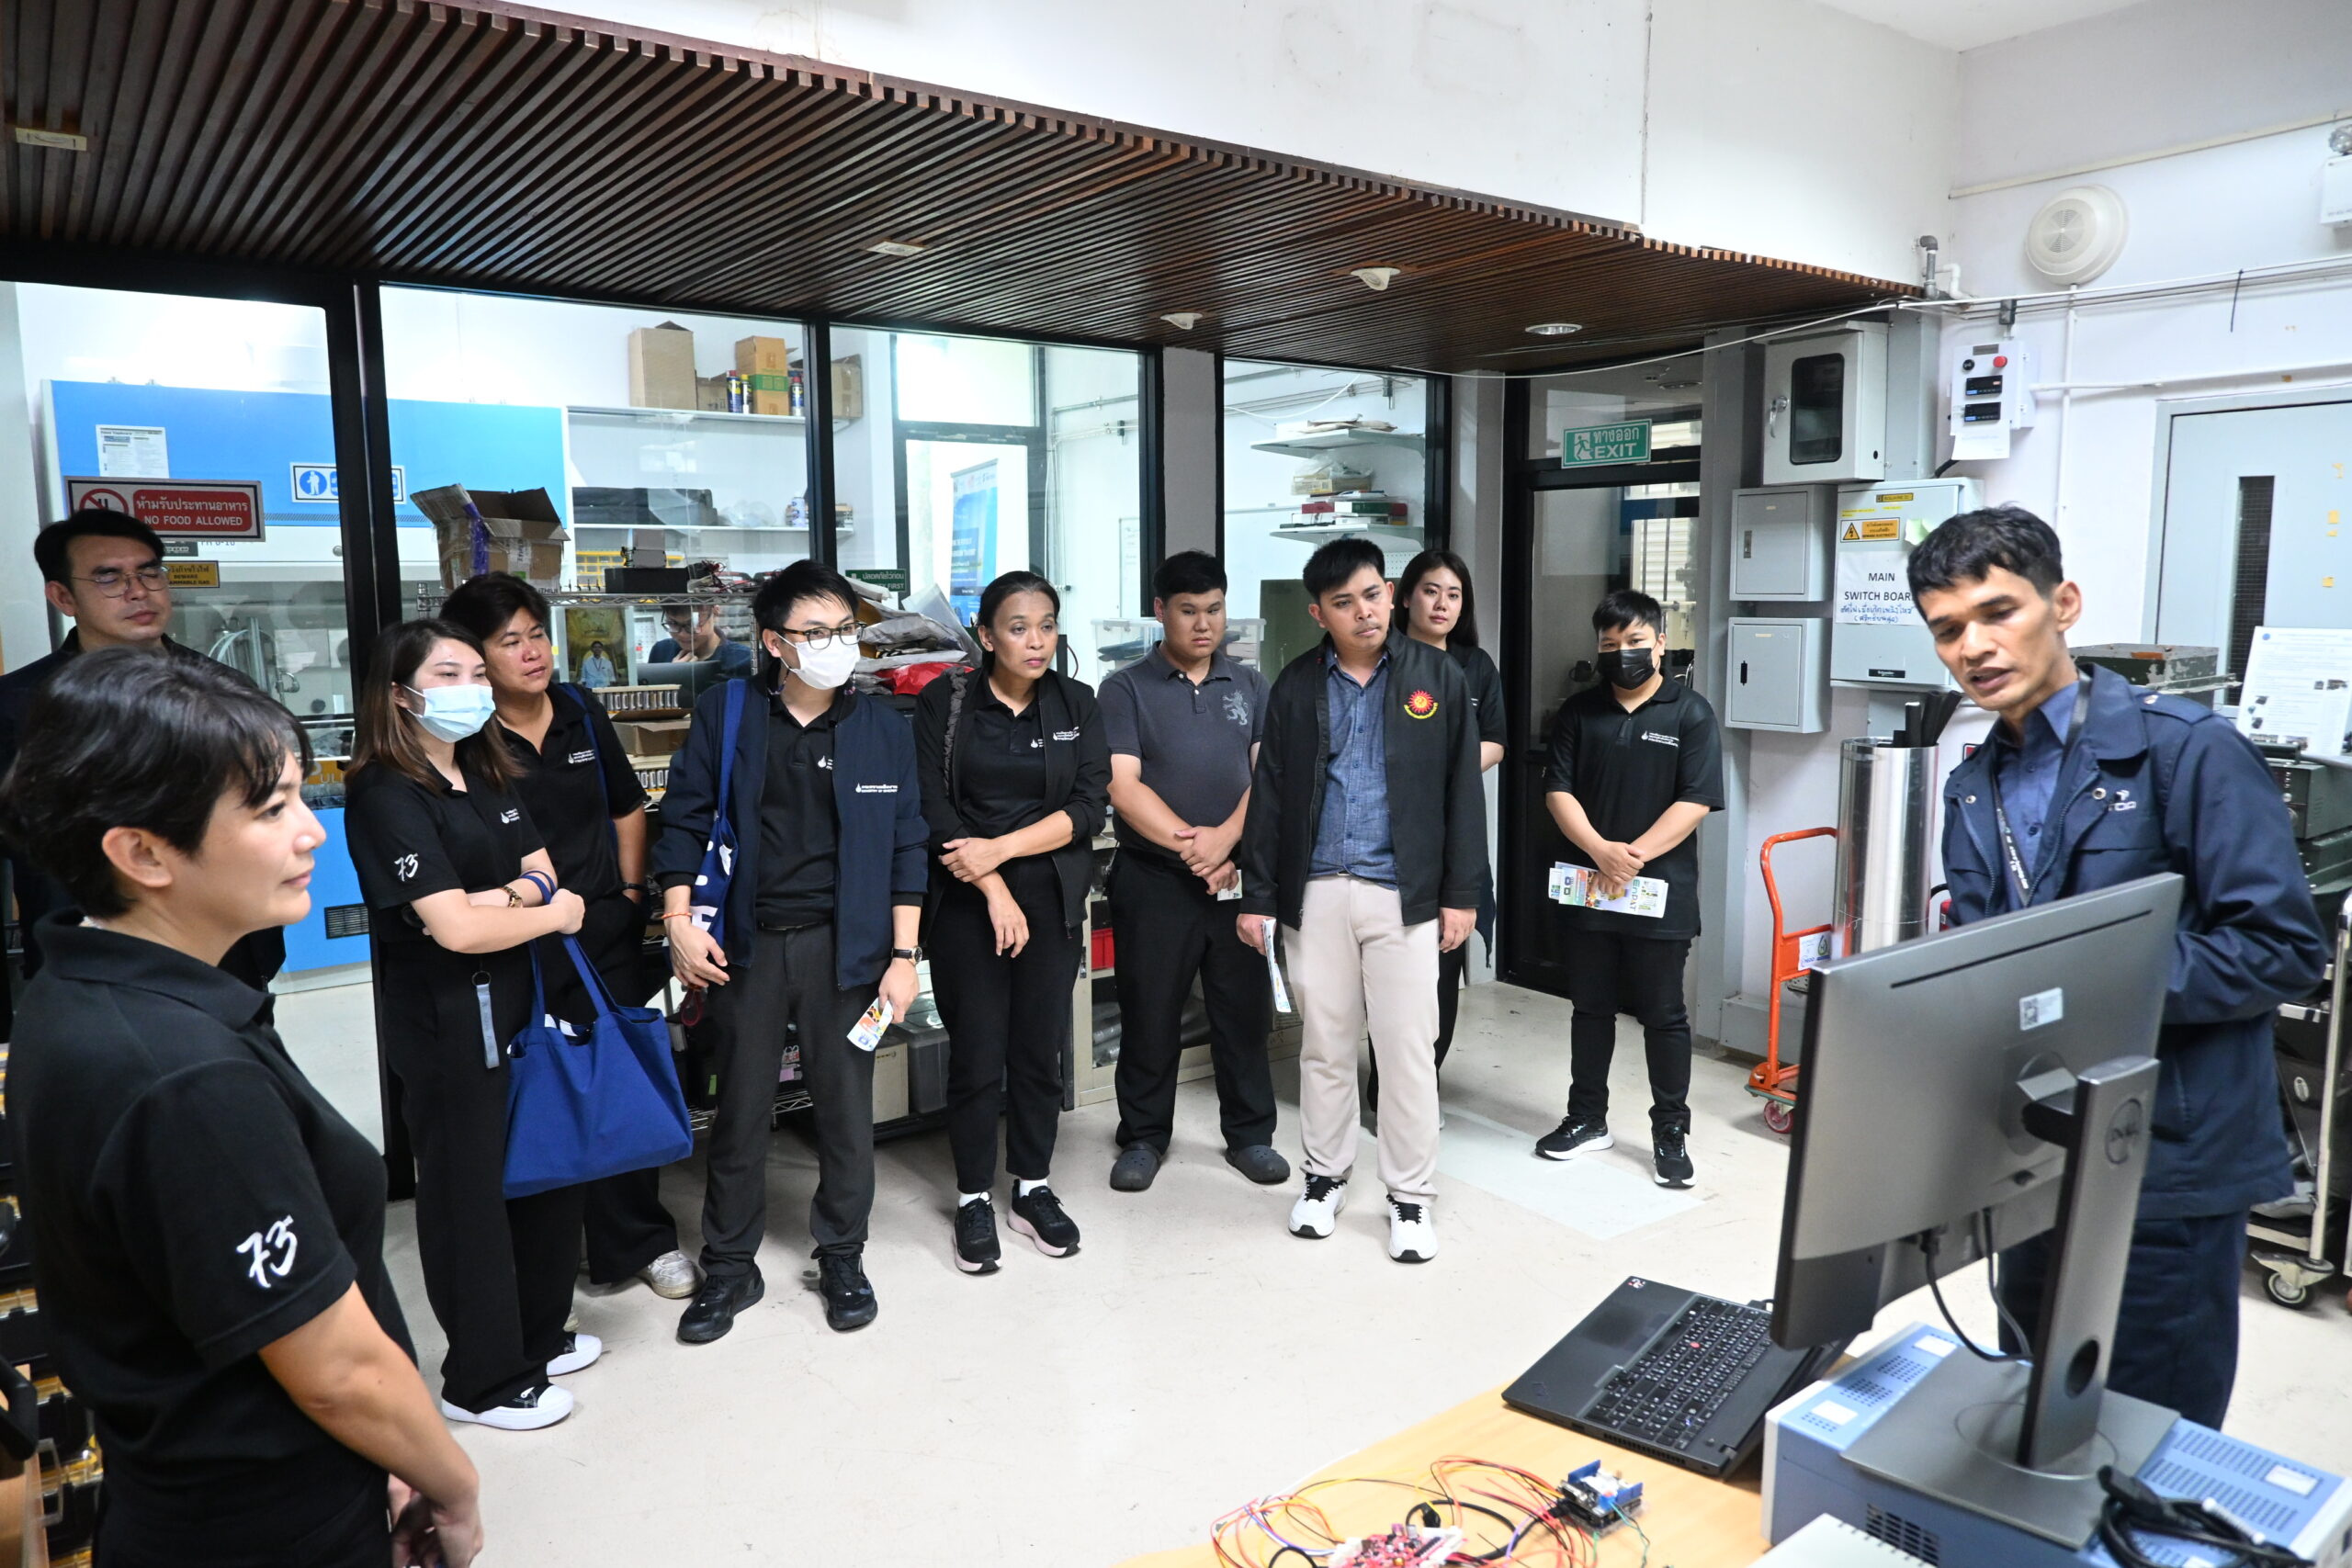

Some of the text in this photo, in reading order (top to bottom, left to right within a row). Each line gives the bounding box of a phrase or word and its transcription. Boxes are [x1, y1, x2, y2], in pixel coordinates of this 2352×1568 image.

[1593, 427, 1639, 443] ทางออก
[1594, 443, 1636, 458] EXIT
[136, 496, 248, 511] ห้ามรับประทานอาหาร
[144, 516, 243, 525] NO FOOD ALLOWED
[1868, 573, 1895, 581] MAIN
[1844, 592, 1913, 601] SWITCH BOAR
